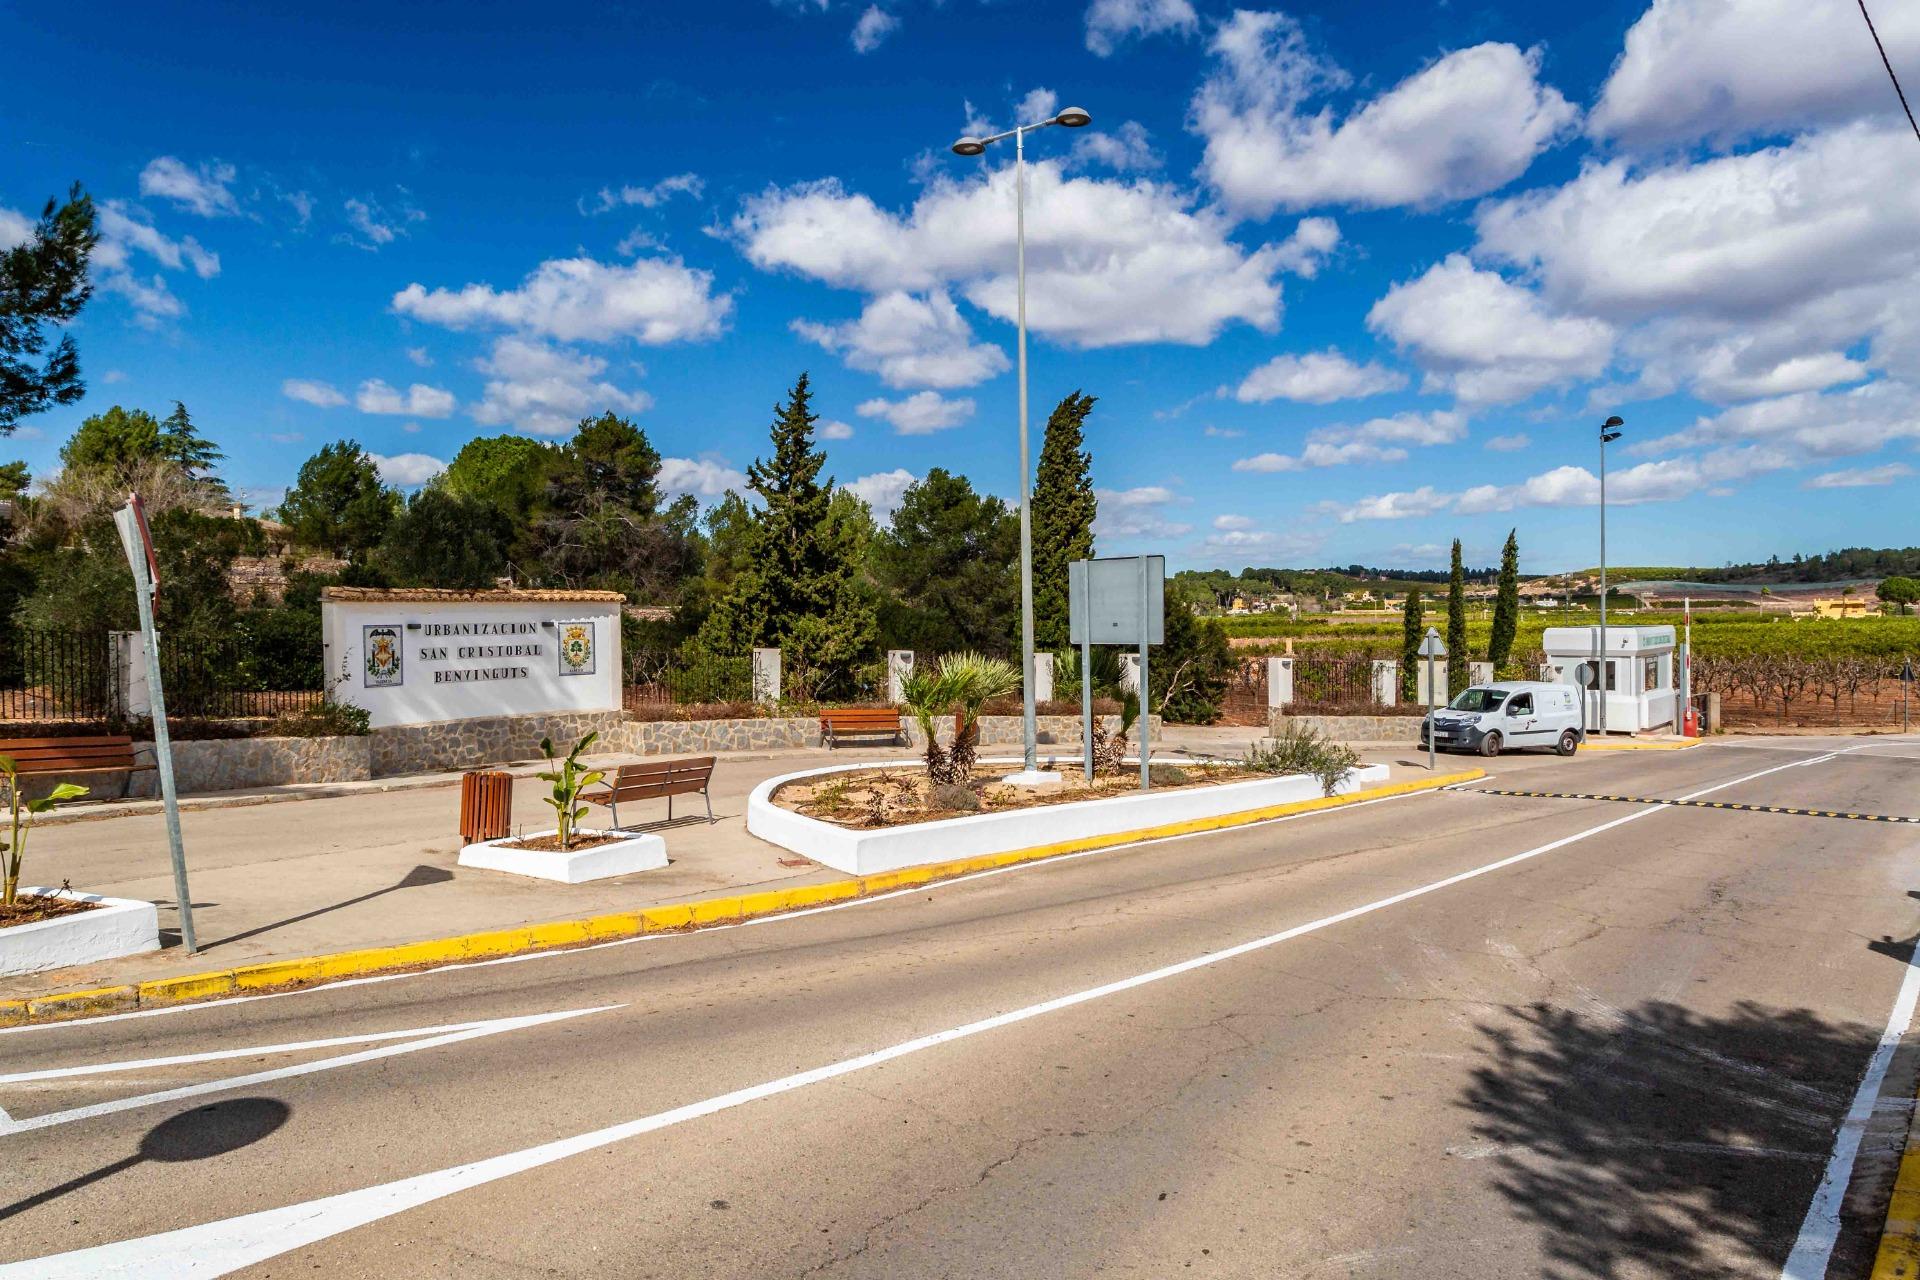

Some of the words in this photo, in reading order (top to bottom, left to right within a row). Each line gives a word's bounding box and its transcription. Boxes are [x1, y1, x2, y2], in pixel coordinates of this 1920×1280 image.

[424, 623, 537, 636] URBANIZACION
[421, 647, 447, 659] SAN
[458, 644, 541, 658] CRISTOBAL
[435, 667, 528, 682] BENVINGUTS
